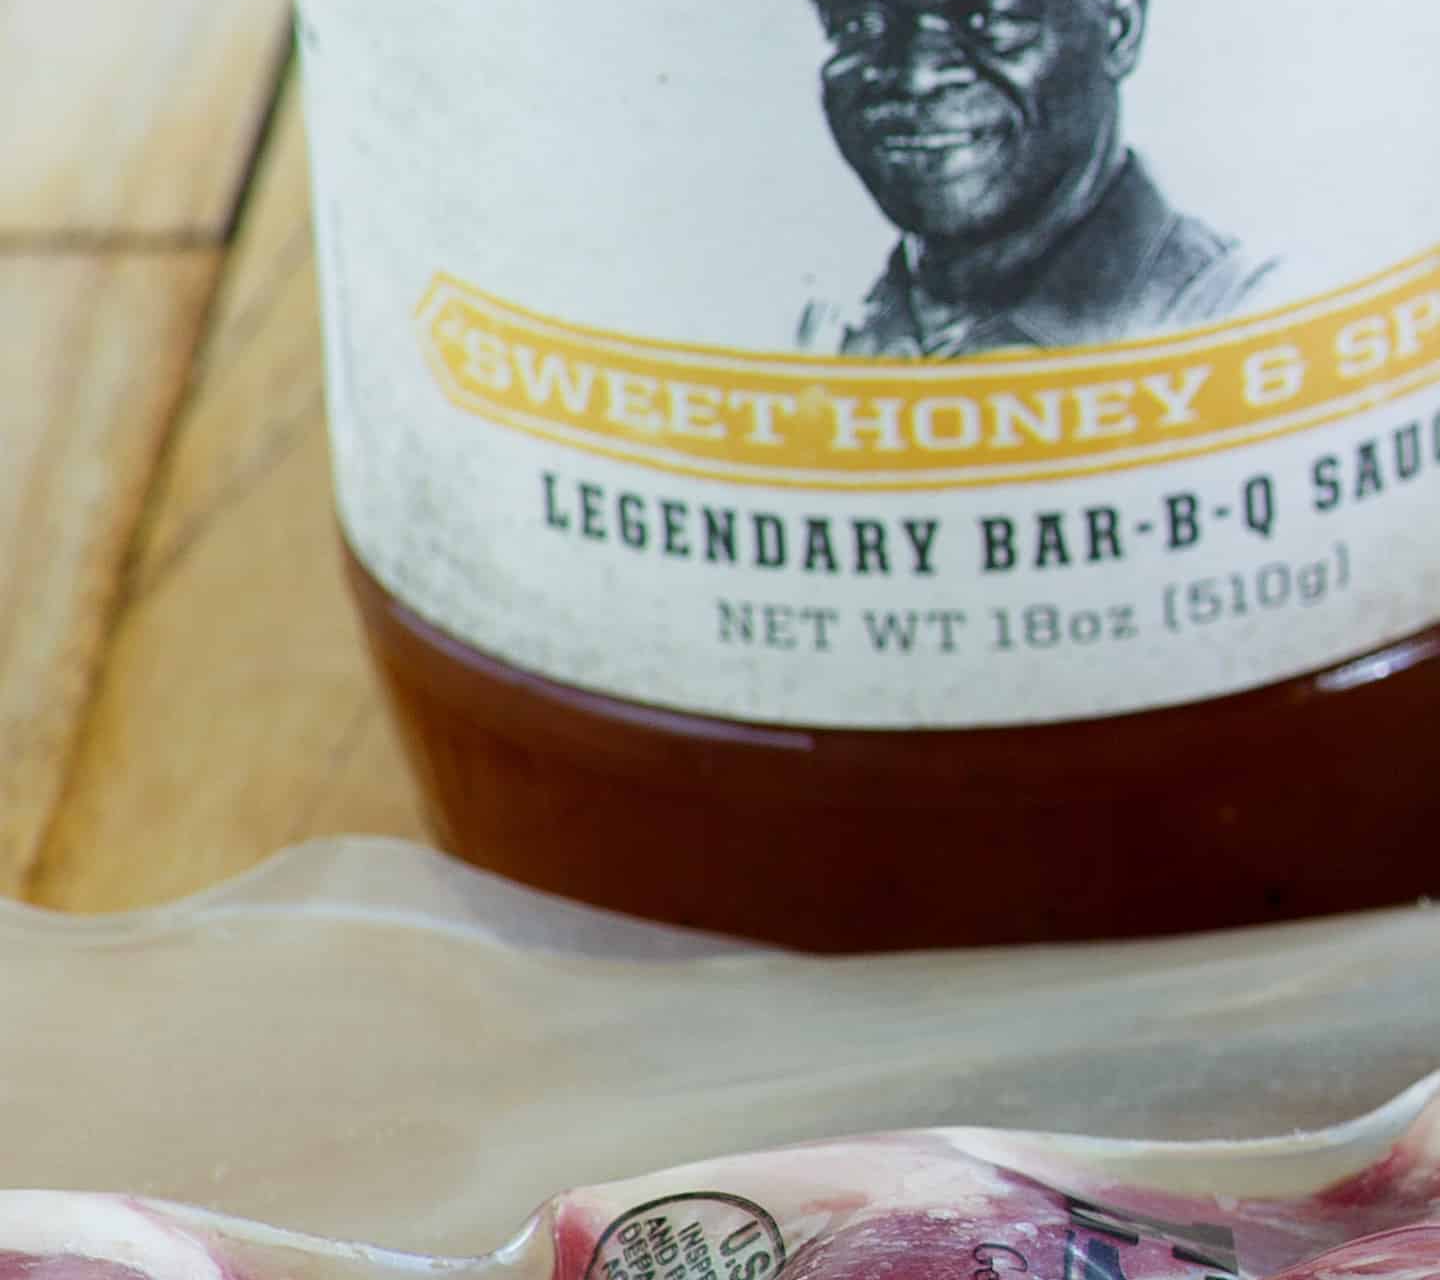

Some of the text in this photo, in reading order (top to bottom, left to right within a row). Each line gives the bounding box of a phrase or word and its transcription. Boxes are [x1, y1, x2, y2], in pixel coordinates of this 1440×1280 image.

[461, 325, 798, 447] SWEET
[831, 364, 1213, 452] HONEY
[1242, 342, 1307, 408] &
[540, 470, 939, 576] LEGENDARY
[979, 473, 1277, 573] BAR-B-Q
[715, 597, 840, 651] NET
[862, 610, 966, 653] WT
[992, 600, 1139, 651] 18oz
